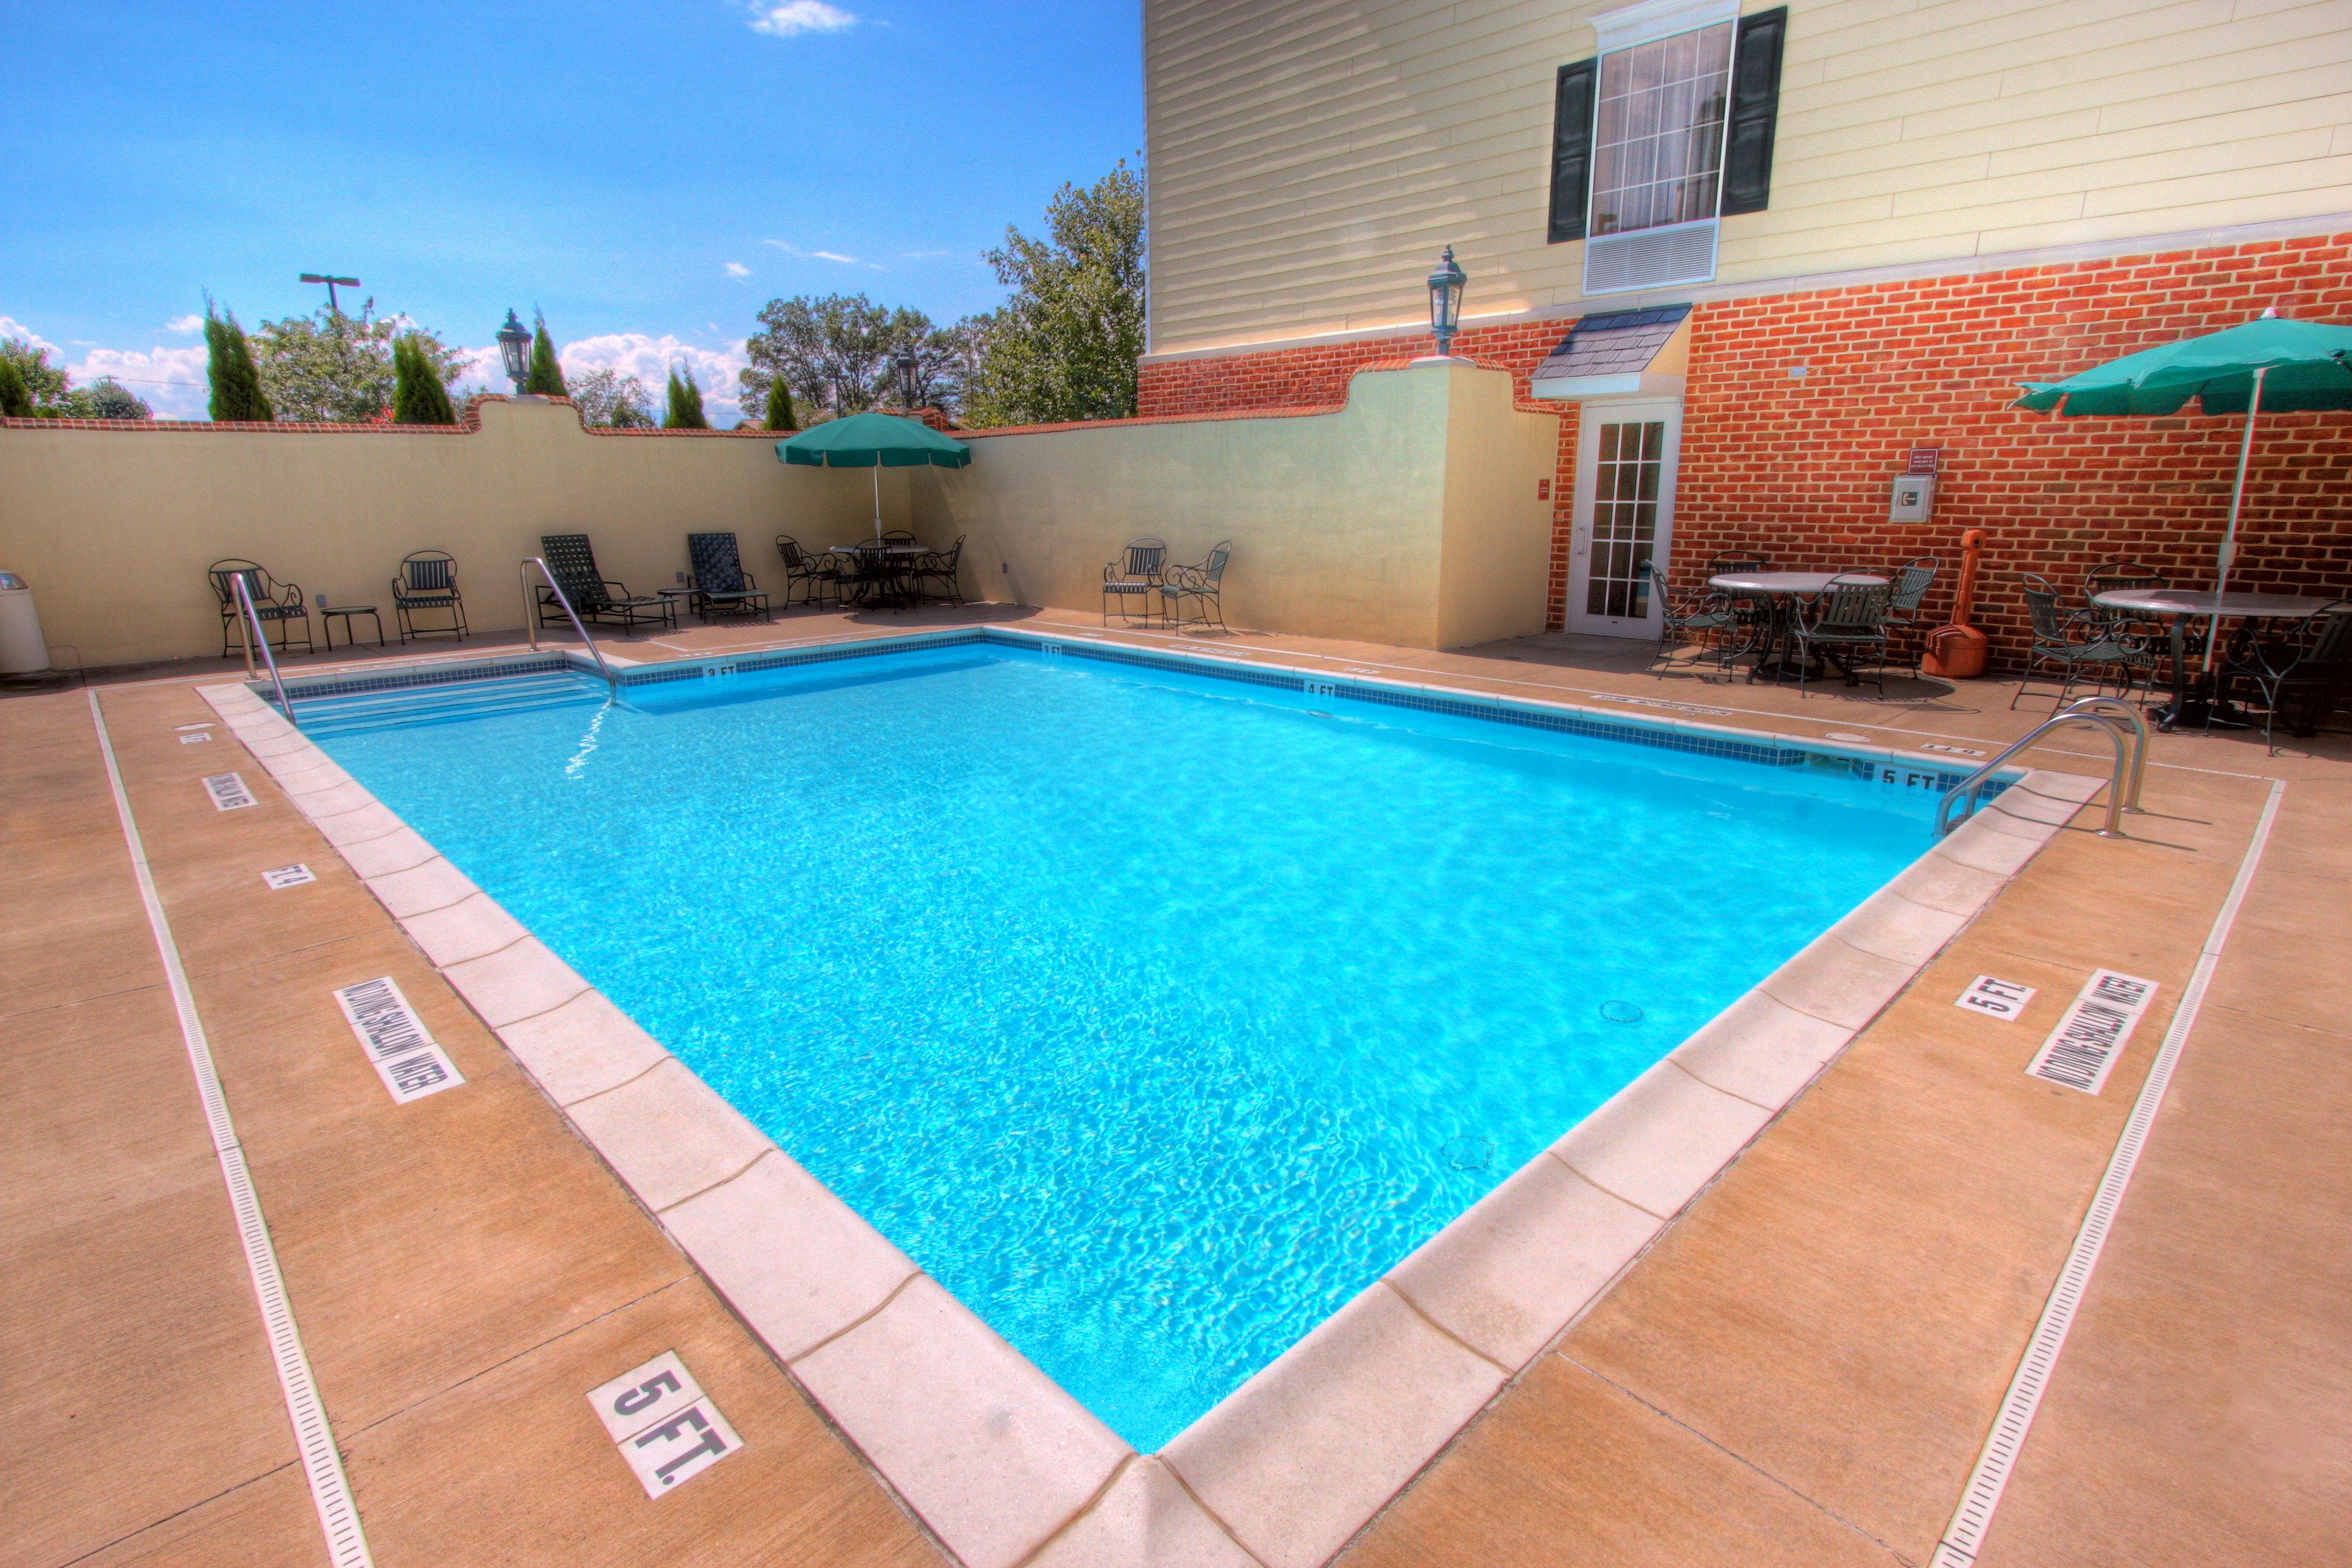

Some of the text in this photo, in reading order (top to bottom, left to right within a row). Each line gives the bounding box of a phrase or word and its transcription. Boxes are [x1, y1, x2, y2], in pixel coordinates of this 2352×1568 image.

[1883, 769, 1896, 784] 5
[342, 979, 448, 1094] NO DIVING SHALLOW WATER
[1966, 996, 2010, 1012] 5
[2036, 975, 2148, 1090] NO DIVING SHALLOW WATER
[613, 1369, 728, 1486] 5 FT.
